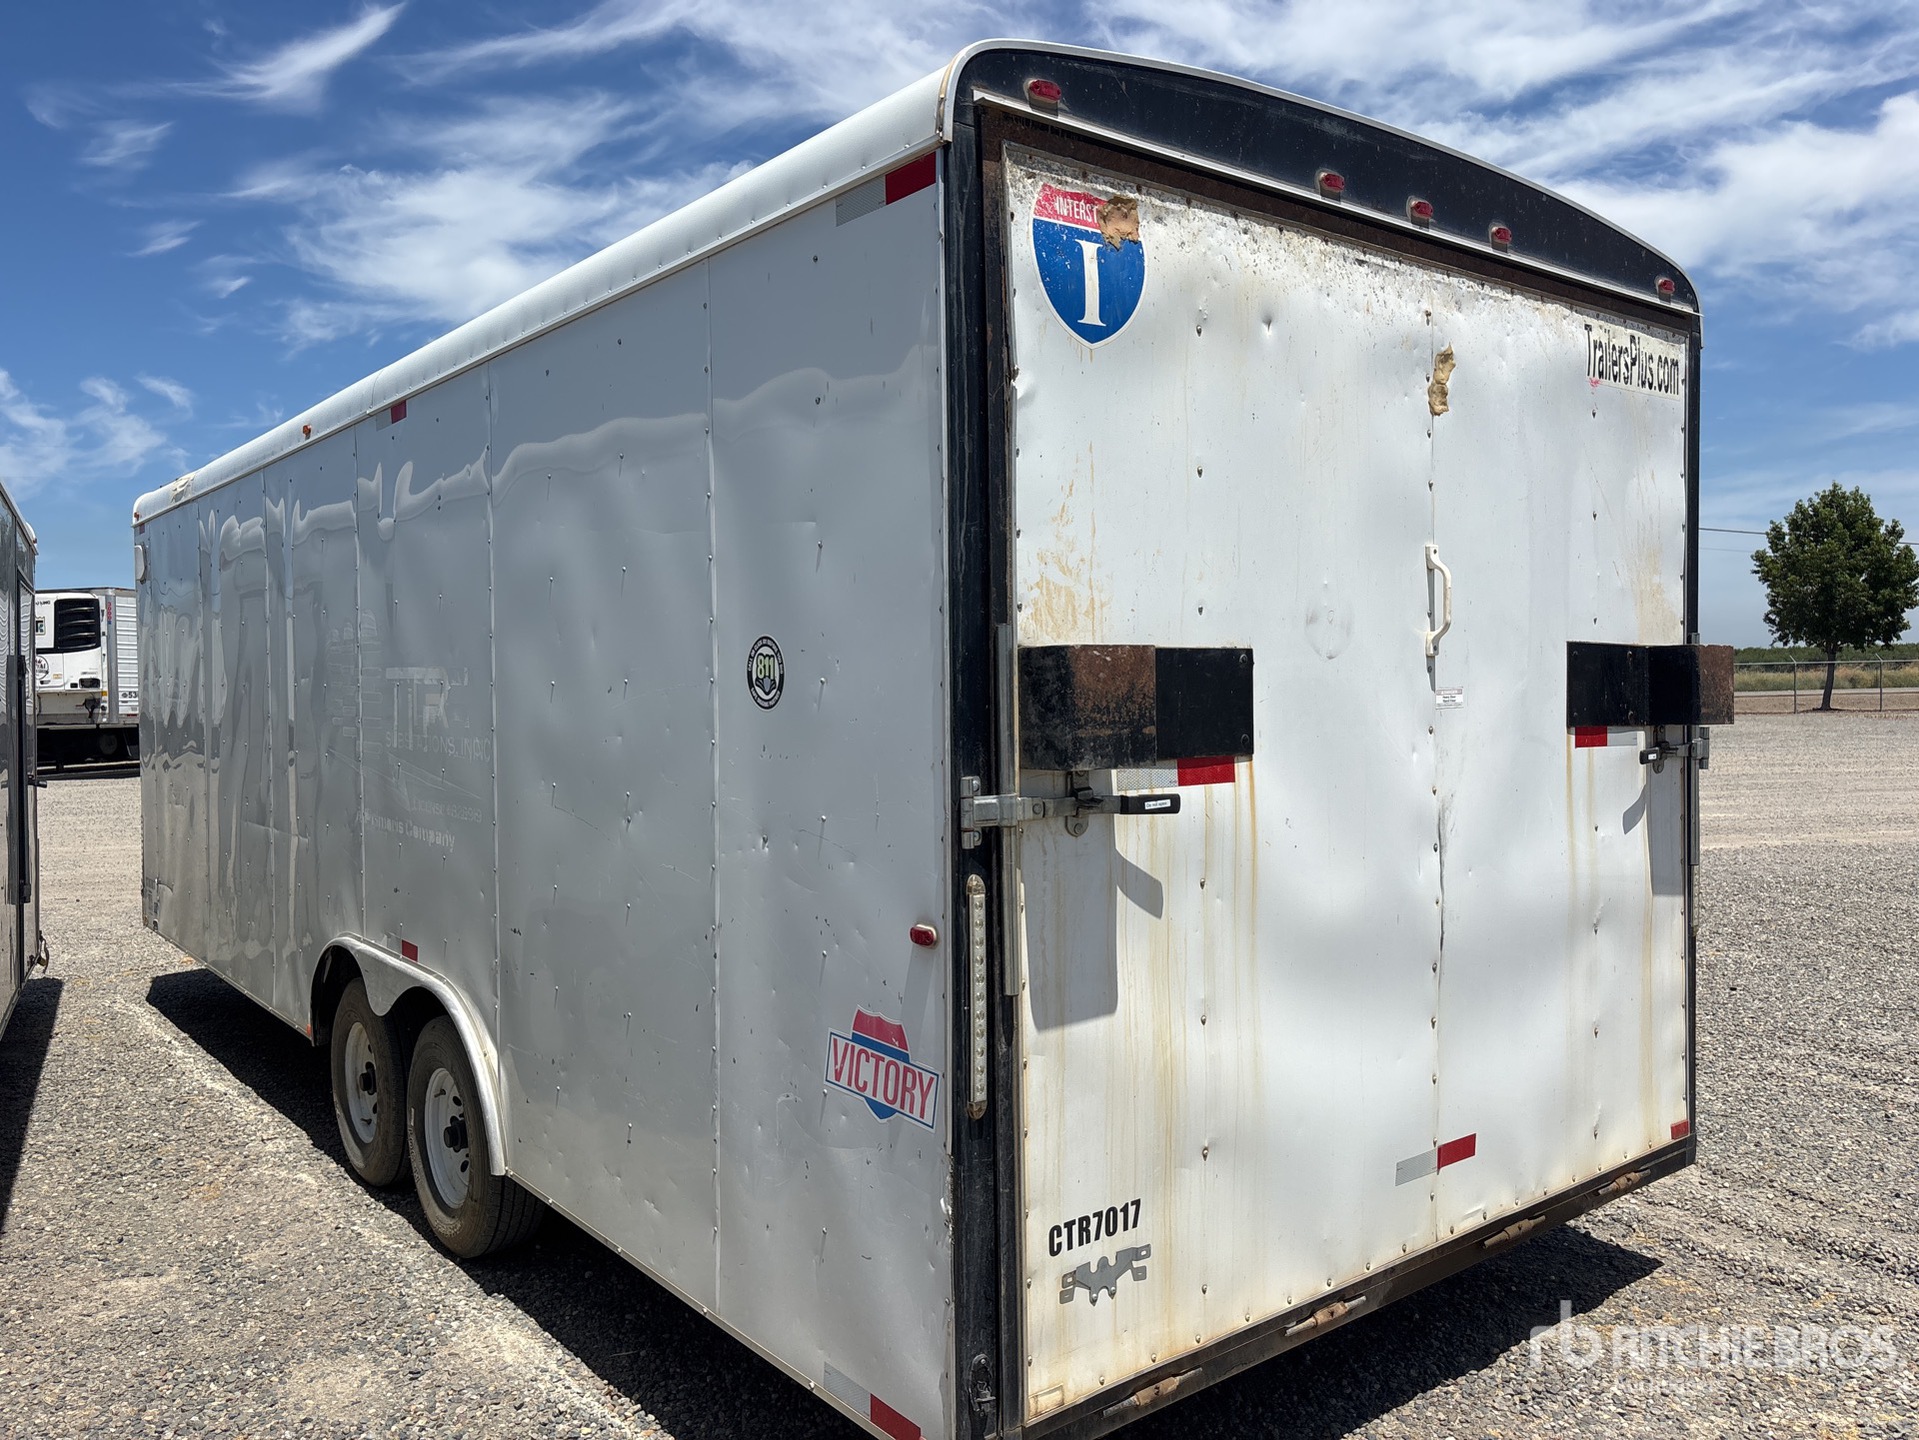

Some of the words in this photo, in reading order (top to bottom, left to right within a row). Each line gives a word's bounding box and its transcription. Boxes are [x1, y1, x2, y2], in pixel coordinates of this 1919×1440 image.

[1055, 197, 1099, 224] INTERST
[1584, 323, 1680, 396] TrailersPlus.com
[757, 654, 775, 680] 811
[833, 1037, 935, 1120] VICTORY
[1049, 1198, 1141, 1258] CTR7017
